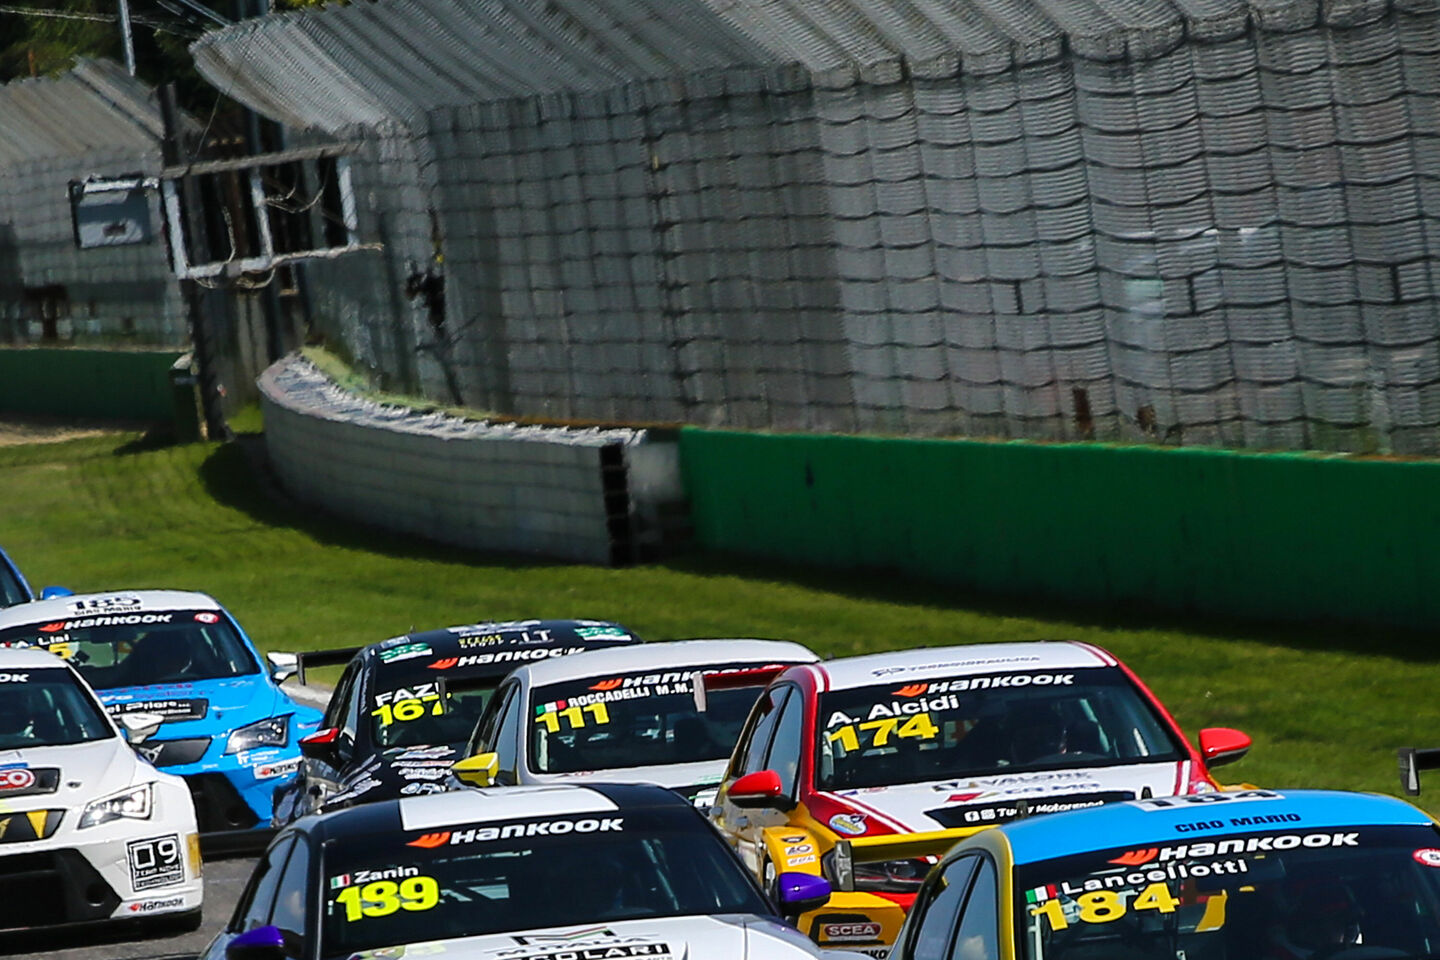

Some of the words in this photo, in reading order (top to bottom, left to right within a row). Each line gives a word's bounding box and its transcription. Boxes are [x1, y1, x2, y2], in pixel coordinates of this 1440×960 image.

[568, 687, 650, 708] ROCCADELLI
[869, 694, 959, 719] Alcidi
[535, 703, 610, 733] 111
[828, 712, 939, 753] 174
[1174, 820, 1225, 833] CIAO
[1230, 813, 1302, 827] MARIO
[354, 865, 419, 885] Zanin
[1061, 858, 1248, 895] Lancellotti
[1030, 882, 1180, 932] 184
[828, 924, 876, 936] SCEA
